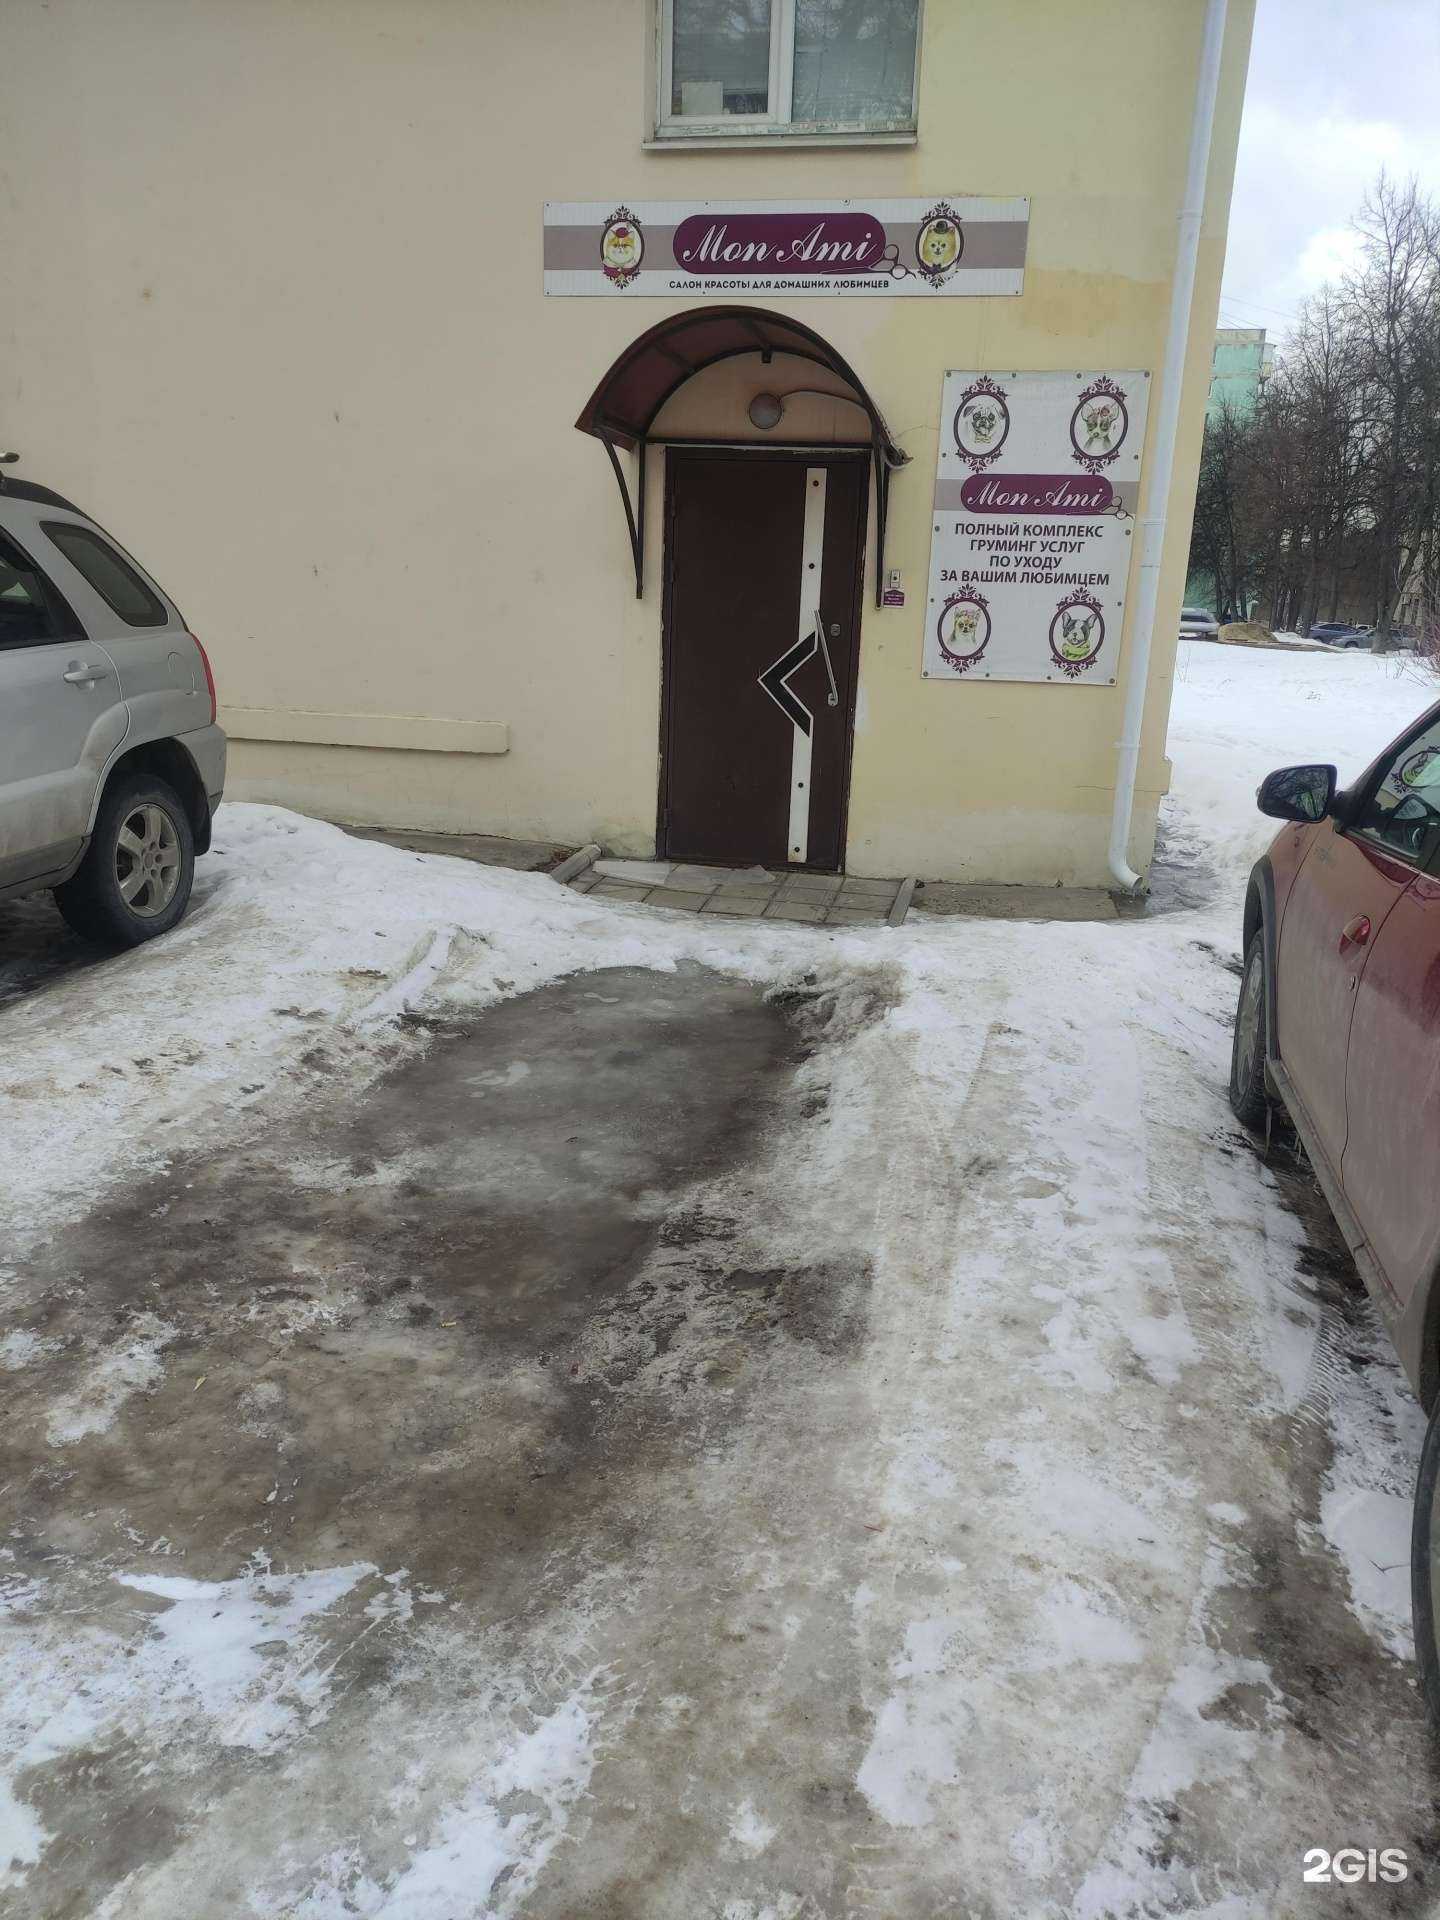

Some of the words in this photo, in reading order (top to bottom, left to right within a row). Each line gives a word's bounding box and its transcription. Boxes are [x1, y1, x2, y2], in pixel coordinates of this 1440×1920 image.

[682, 223, 778, 262] Mon
[776, 222, 878, 262] Ami
[669, 280, 702, 290] САЛОН
[704, 280, 750, 289] КРАСОТЫ
[752, 280, 772, 289] ДЛЯ
[773, 279, 831, 289] ДОМАШНИХ
[833, 279, 889, 289] ЛЮБИМЦЕВ
[967, 481, 1035, 506] Mon
[1034, 481, 1107, 508] Ami
[955, 522, 1020, 536] ПОЛНЫЙ
[1023, 524, 1104, 538] КОМПЛЕКС
[970, 539, 1037, 552] ГРУМИНГ
[1040, 540, 1085, 554] УСЛУГ
[989, 555, 1011, 568] ПО
[1013, 556, 1063, 570] УХОДУ
[940, 569, 958, 582] ЗА
[961, 570, 1017, 583] ВАШИМ
[1020, 572, 1110, 587] ЛЮБИМЦЕМ
